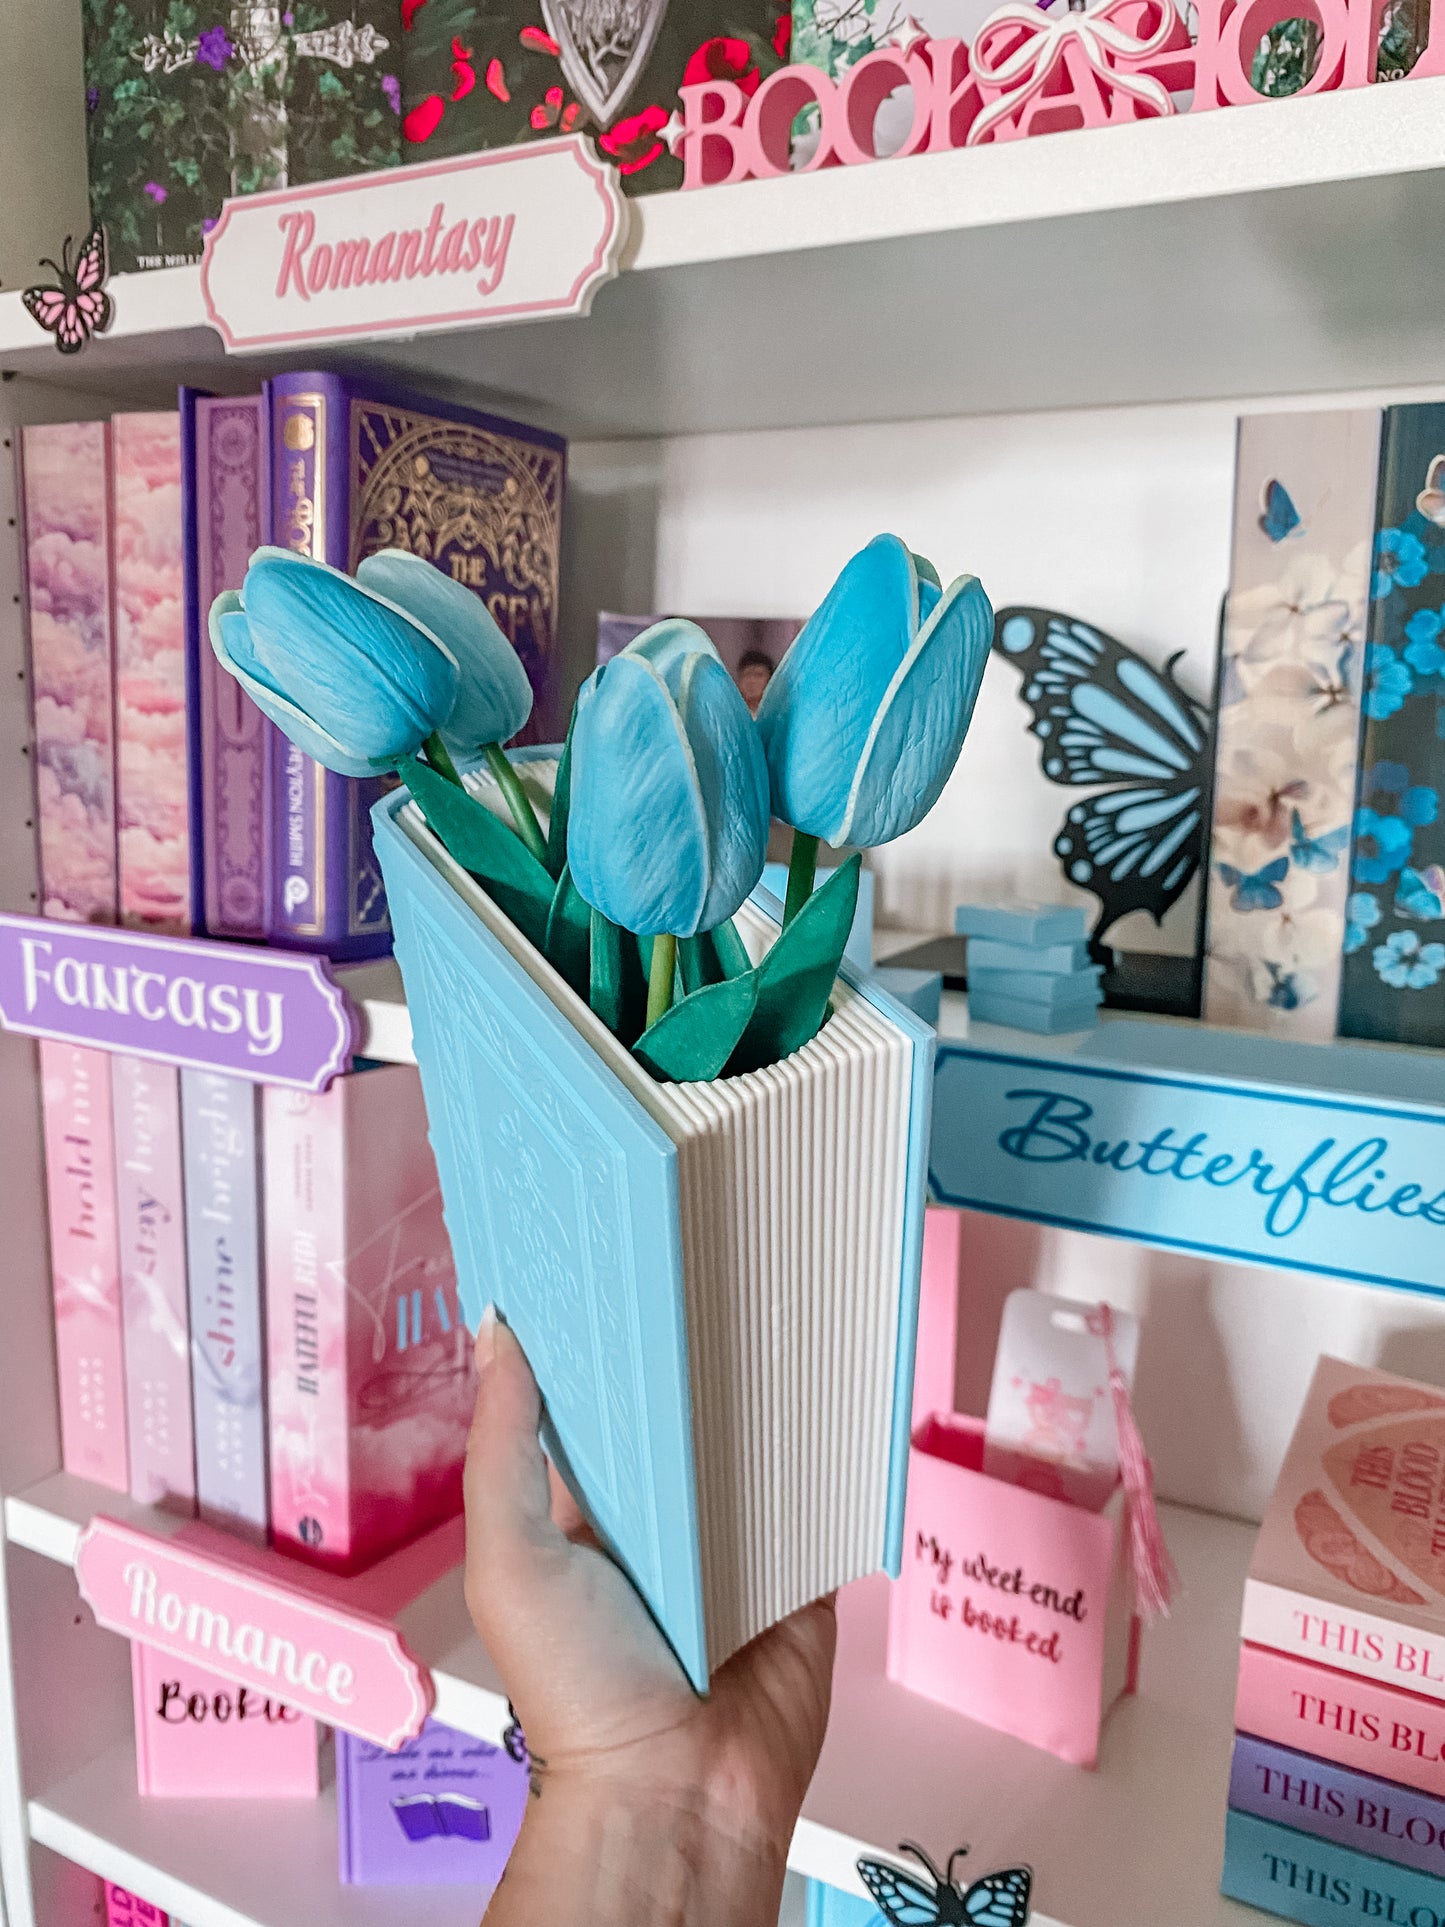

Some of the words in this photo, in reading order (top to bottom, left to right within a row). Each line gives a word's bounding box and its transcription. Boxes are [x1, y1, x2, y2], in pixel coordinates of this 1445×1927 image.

[275, 202, 516, 302] Romantasy
[19, 938, 284, 1057] Fantasy
[65, 1133, 97, 1240] hold
[999, 1089, 1445, 1237] Butterflies
[134, 1185, 172, 1275] stay
[207, 1234, 236, 1367] shine
[1391, 1441, 1440, 1519] BLOOD
[915, 1530, 952, 1585] My
[962, 1553, 1087, 1623] weekend
[123, 1561, 356, 1706] Romance
[962, 1596, 1062, 1664] booked
[1293, 1610, 1384, 1663] THIS
[1394, 1641, 1445, 1683] BL
[1291, 1690, 1380, 1743] THIS
[1389, 1721, 1445, 1763] BL
[1255, 1764, 1345, 1818] THIS
[1355, 1797, 1445, 1850] BLO
[1263, 1853, 1351, 1906] THIS
[1361, 1887, 1445, 1927] BLO
